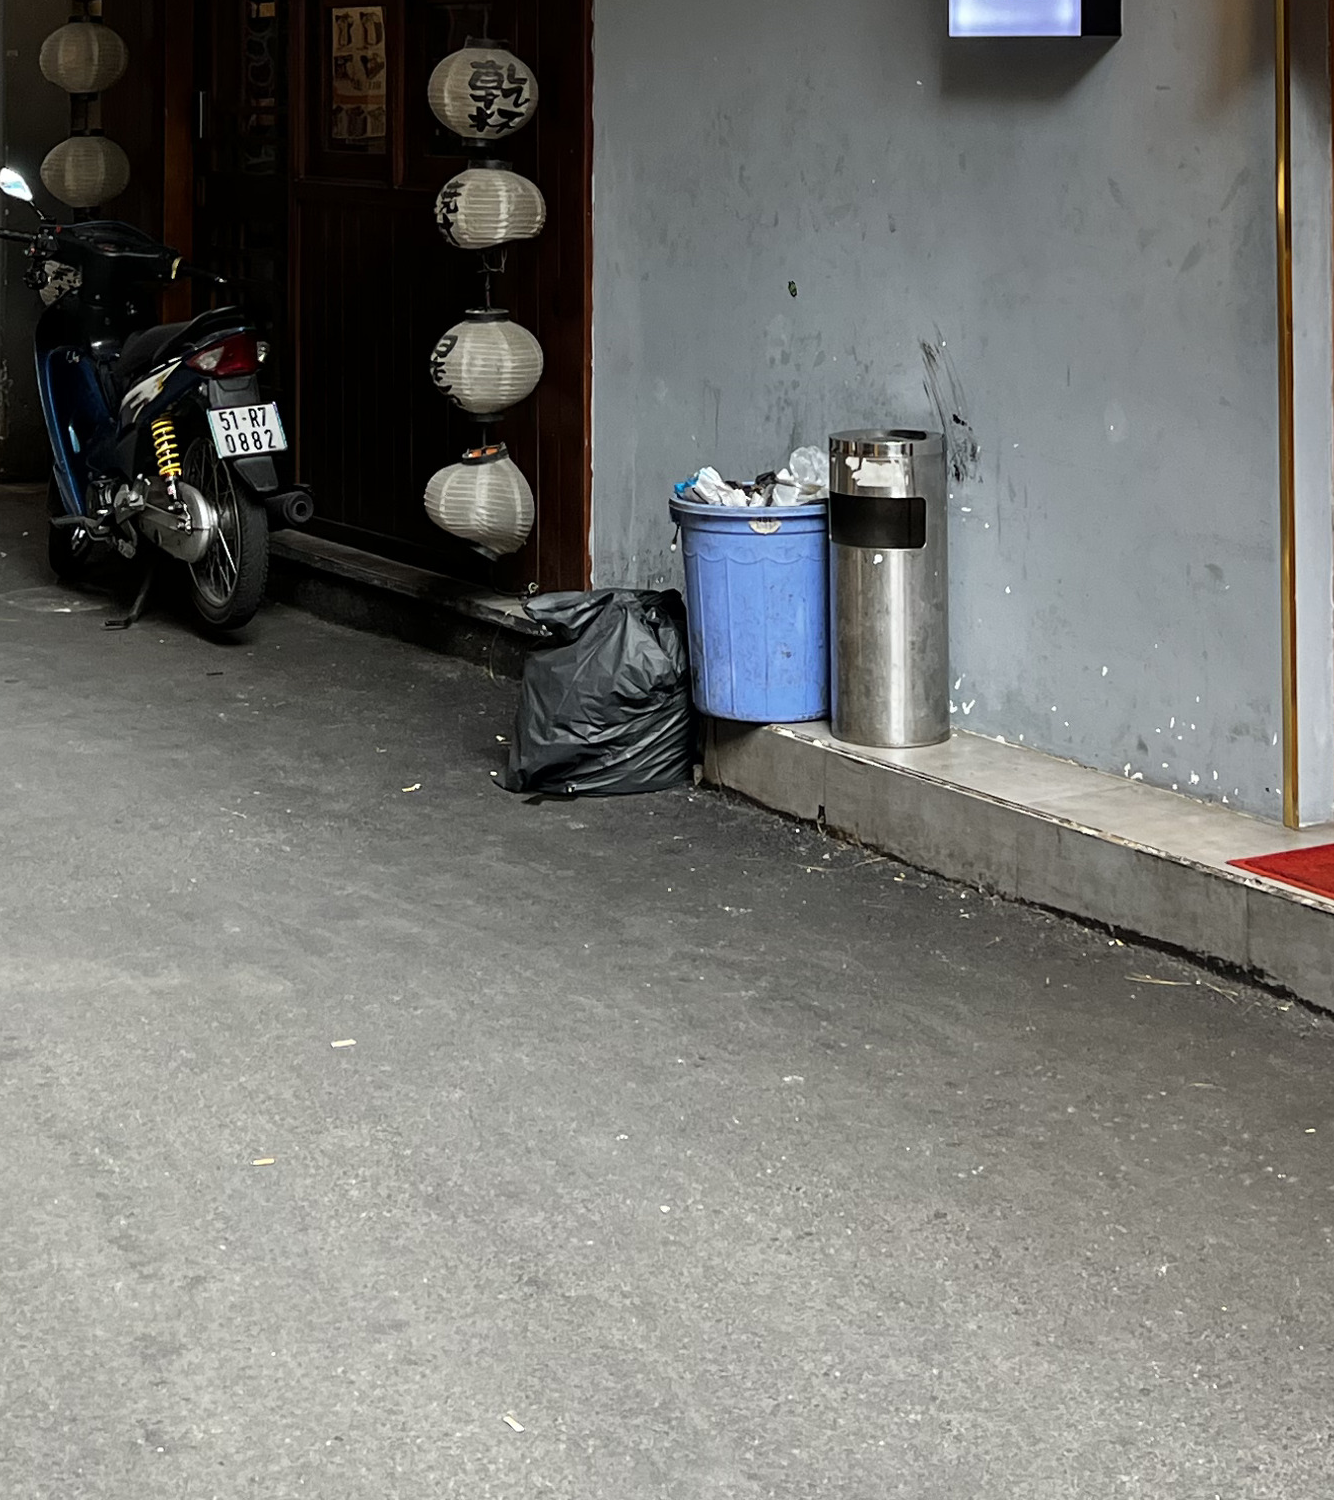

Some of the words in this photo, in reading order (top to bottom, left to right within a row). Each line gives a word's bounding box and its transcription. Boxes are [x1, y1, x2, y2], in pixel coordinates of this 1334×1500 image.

[468, 58, 530, 135] 乾杯
[219, 408, 267, 432] 51-R7
[224, 428, 276, 454] 0882
